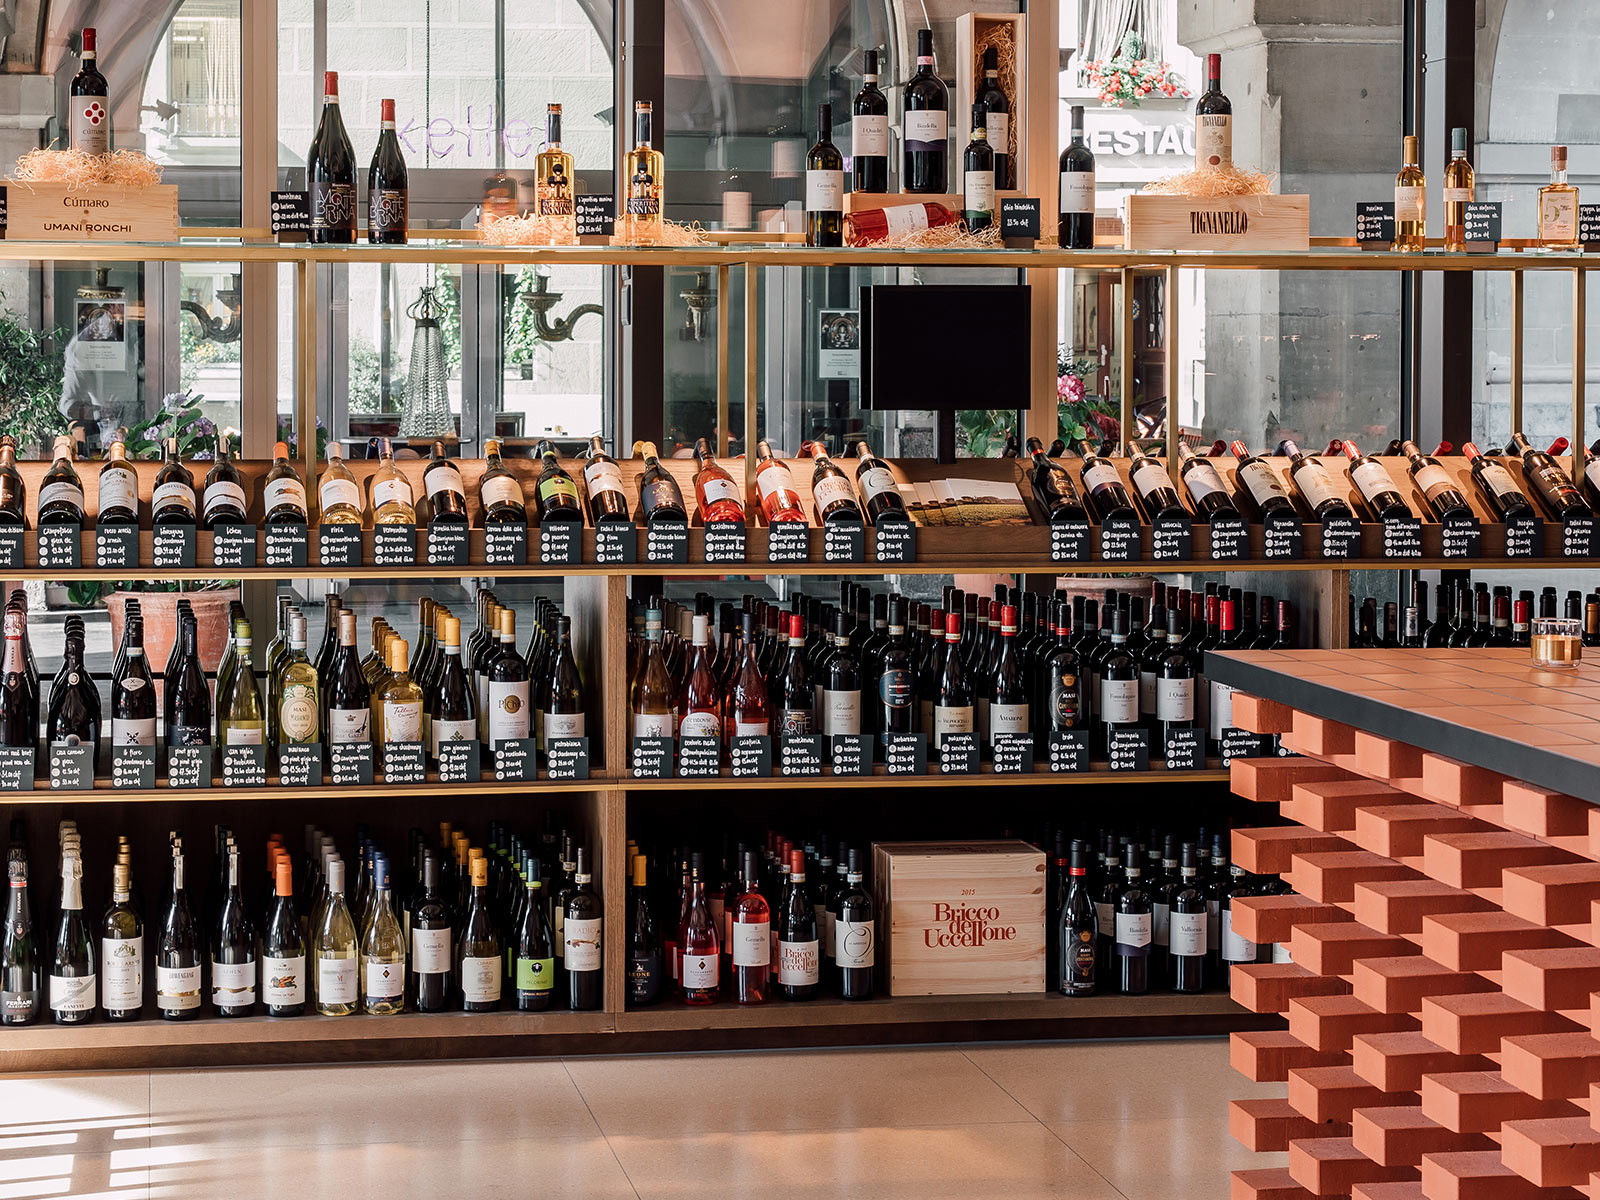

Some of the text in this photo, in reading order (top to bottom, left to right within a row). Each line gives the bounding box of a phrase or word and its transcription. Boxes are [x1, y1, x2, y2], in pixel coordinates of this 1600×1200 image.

[1202, 116, 1227, 128] TIGNANELLO
[44, 223, 132, 232] UMANI RONCHI
[1190, 212, 1248, 234] TIGNANELLO
[932, 902, 1000, 922] Bricco
